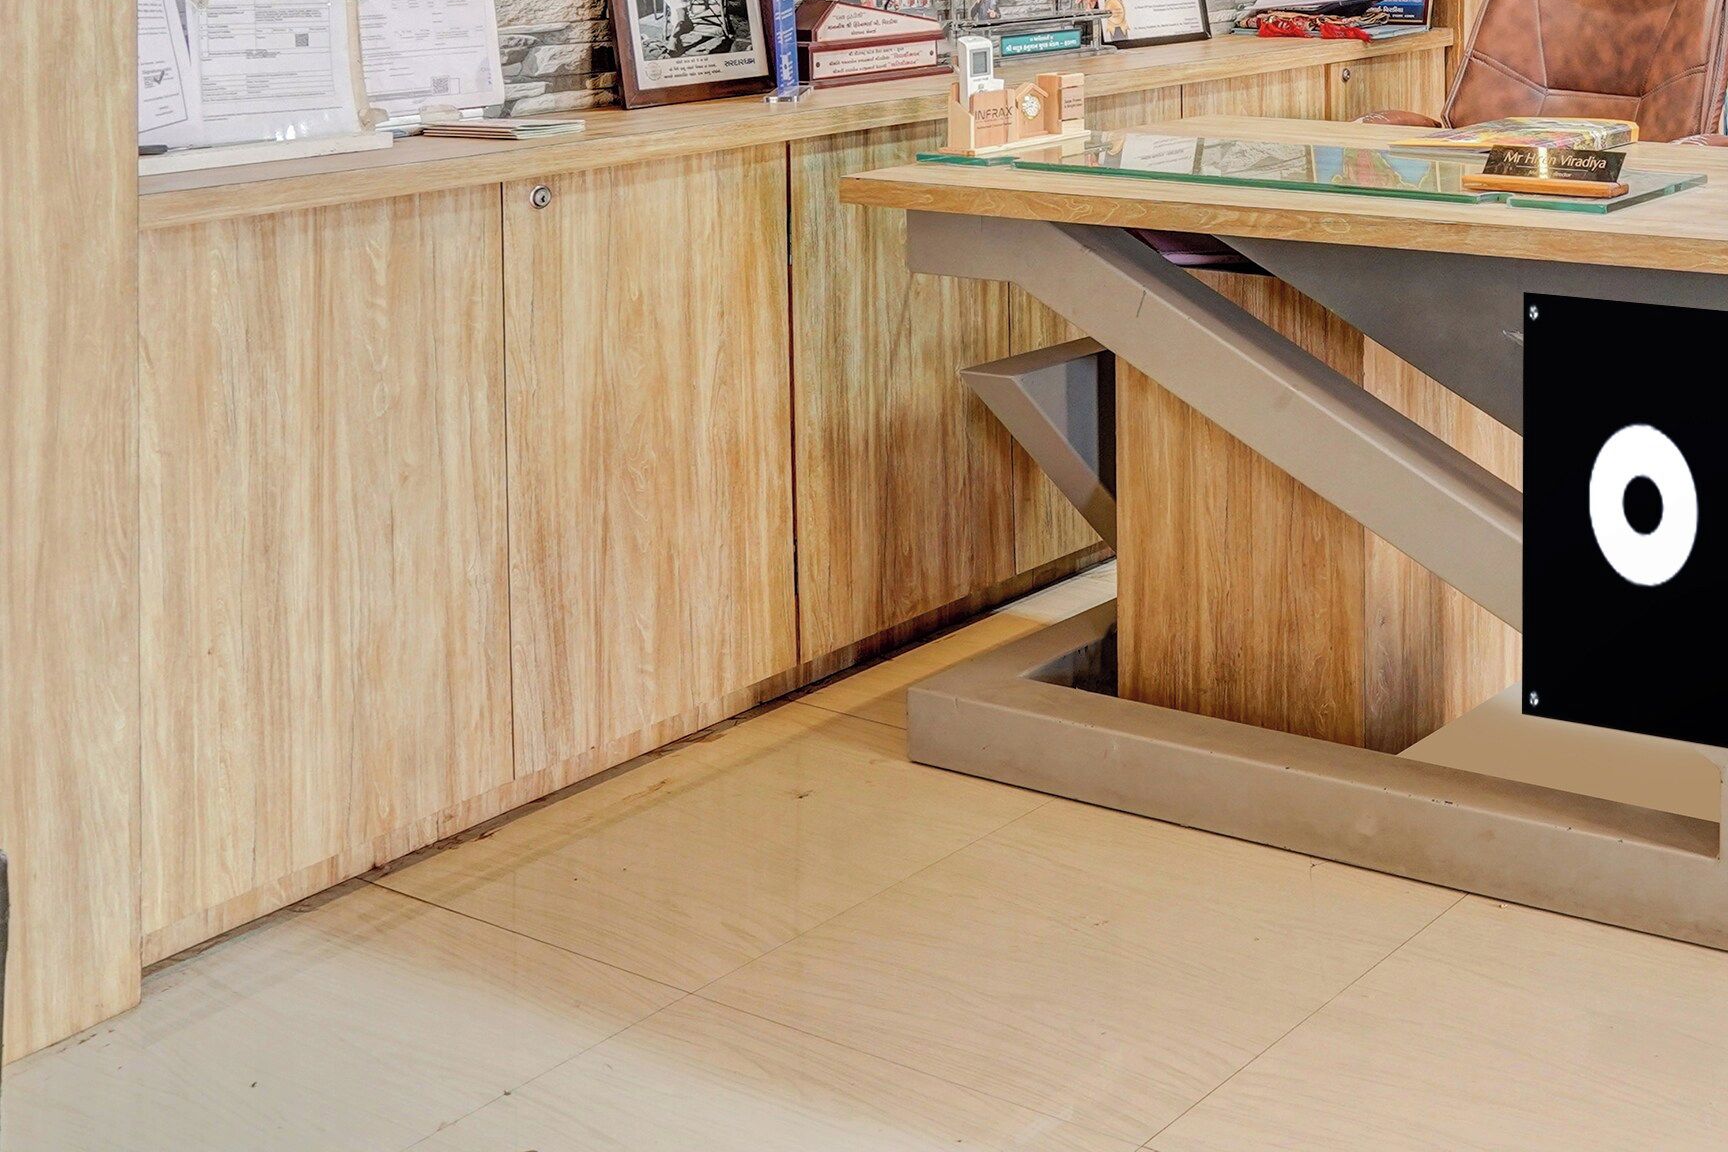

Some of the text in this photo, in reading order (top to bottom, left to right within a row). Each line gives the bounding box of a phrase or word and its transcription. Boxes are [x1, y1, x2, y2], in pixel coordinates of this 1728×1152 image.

[974, 106, 1014, 121] INFRAX
[1503, 151, 1523, 164] Mr
[1560, 154, 1607, 172] Viradiya
